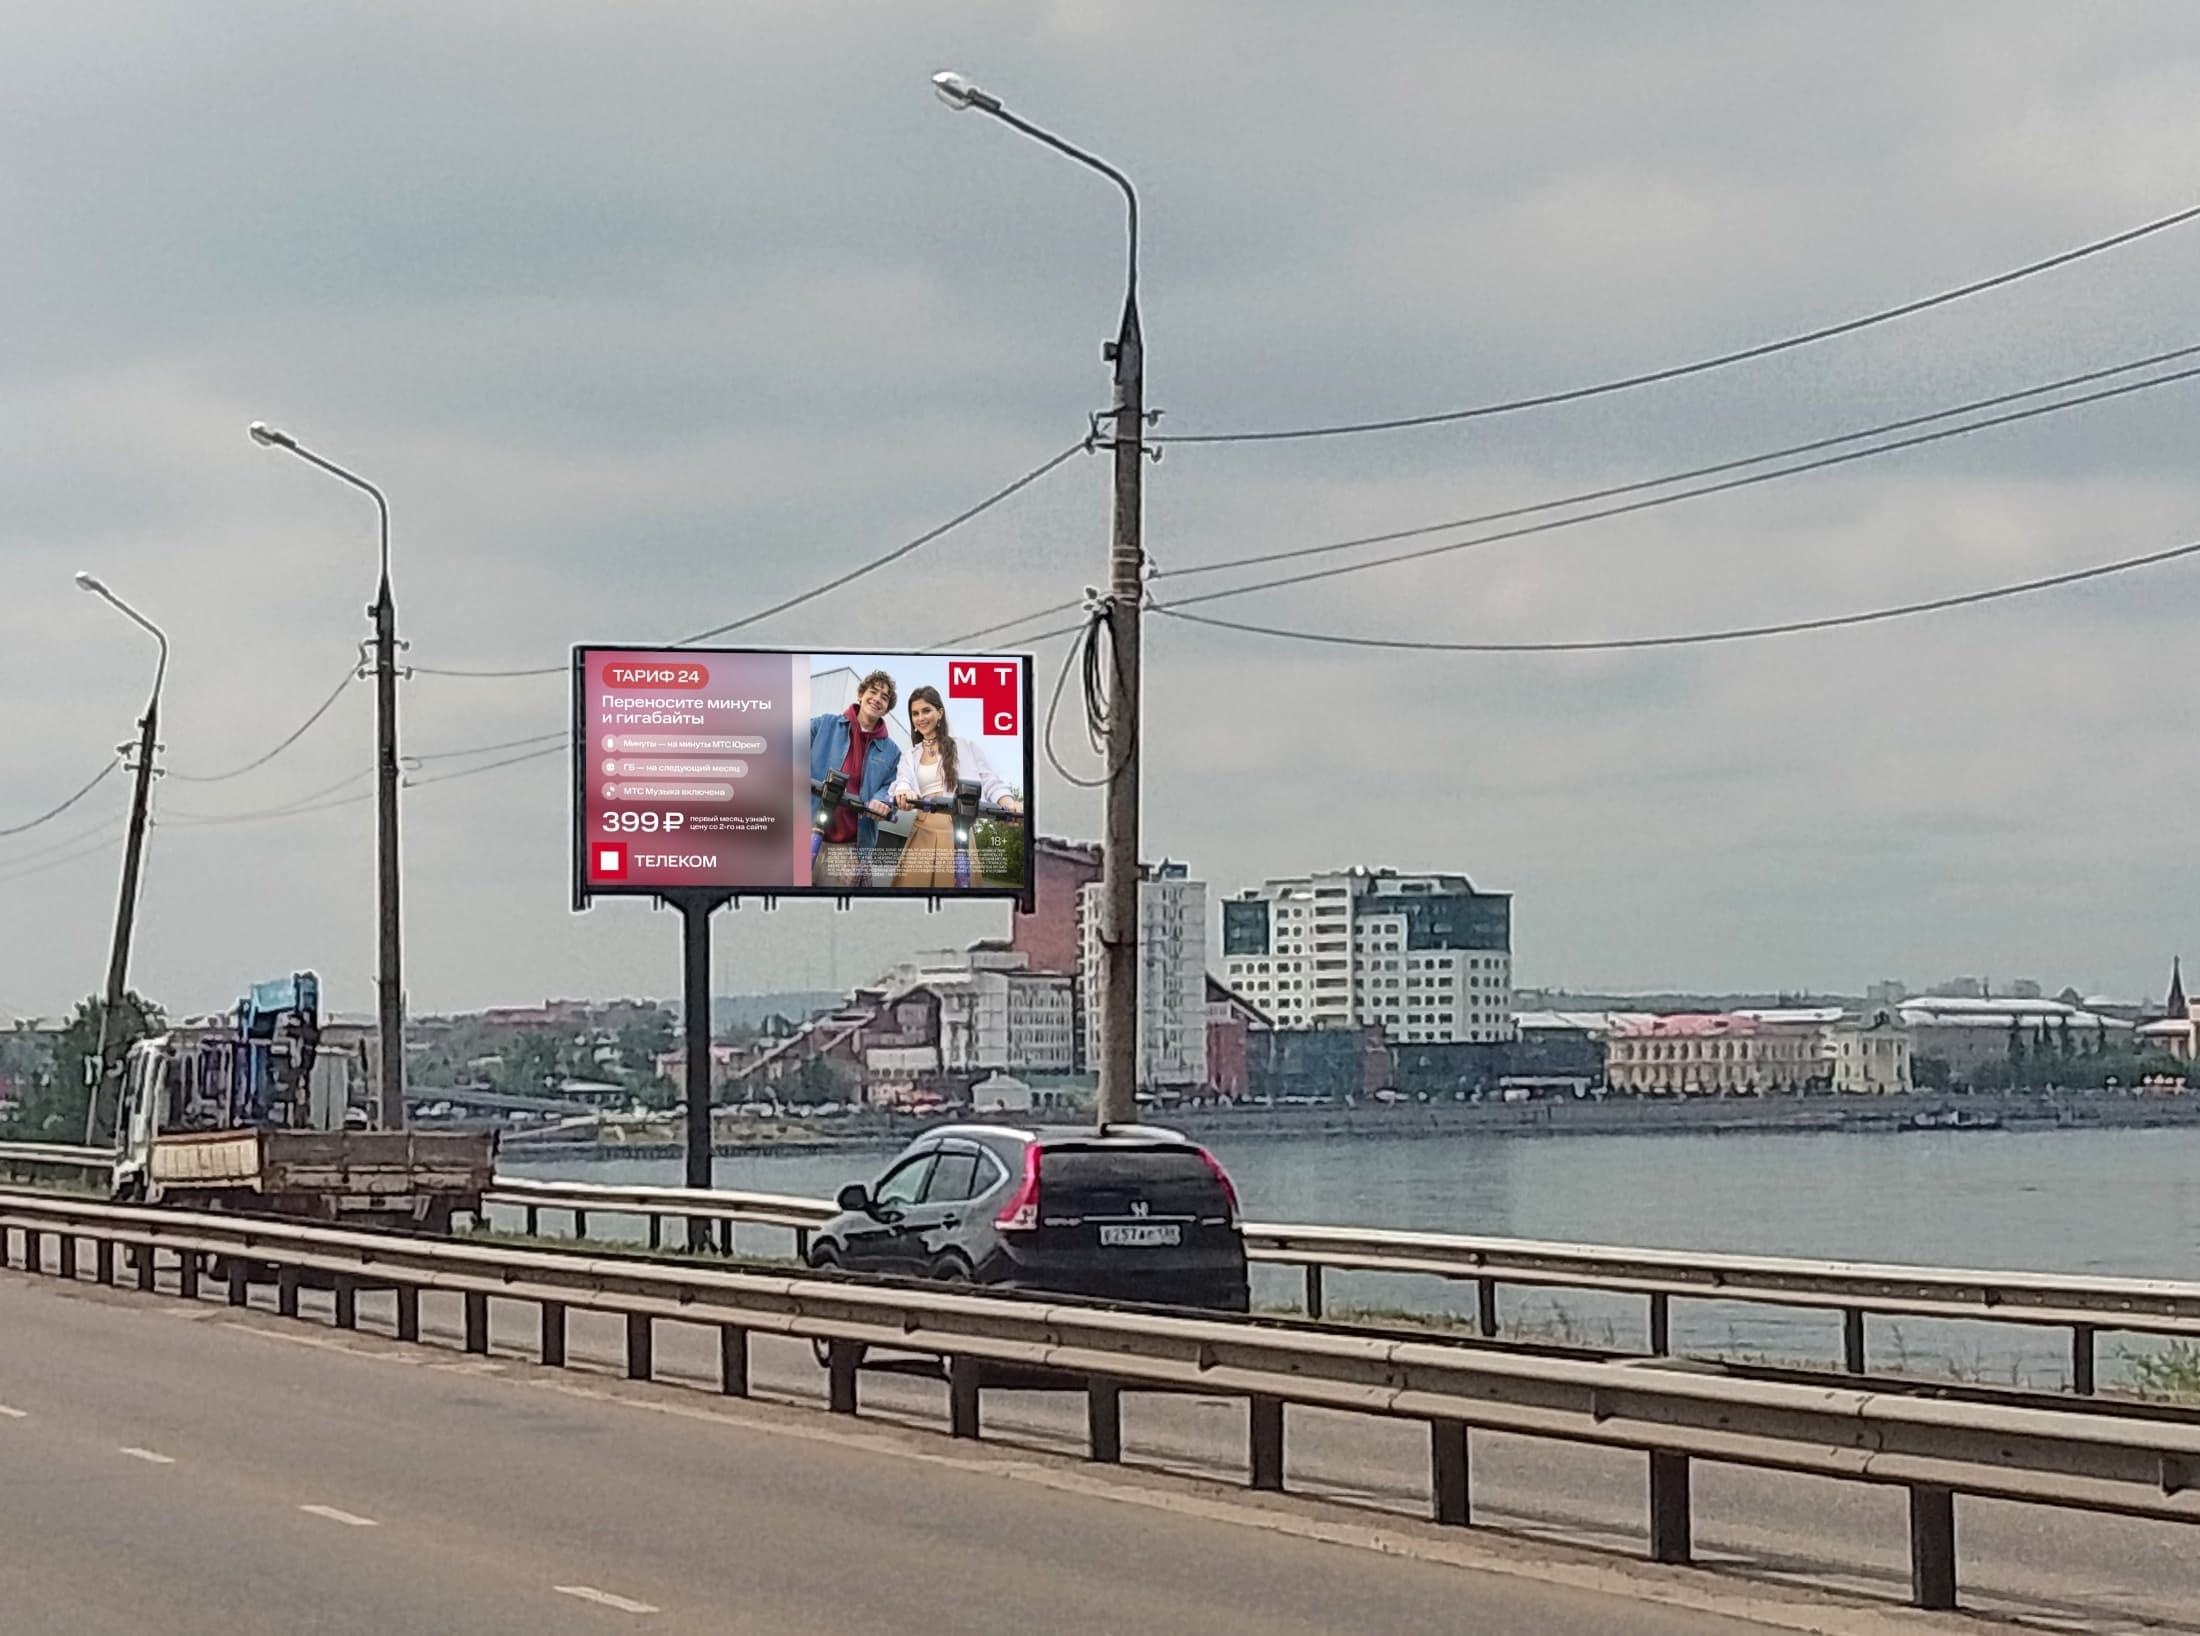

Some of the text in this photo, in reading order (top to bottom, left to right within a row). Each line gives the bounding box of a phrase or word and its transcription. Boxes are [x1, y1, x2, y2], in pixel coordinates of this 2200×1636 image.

[613, 669, 700, 683] ТАРИФ 24
[602, 695, 772, 712] Переносите минуты
[602, 711, 704, 725] и гигабайты
[623, 740, 657, 749] Минуты
[679, 741, 711, 750] минуты
[712, 740, 731, 749] МТС
[623, 763, 635, 771] ГБ
[623, 787, 726, 798] МТС Музыка включена
[689, 815, 719, 824] первый
[744, 815, 776, 824] узнайте
[746, 823, 768, 831] сайте
[991, 836, 1007, 846] 18+
[634, 855, 717, 868] ТЕЛЕКОМ
